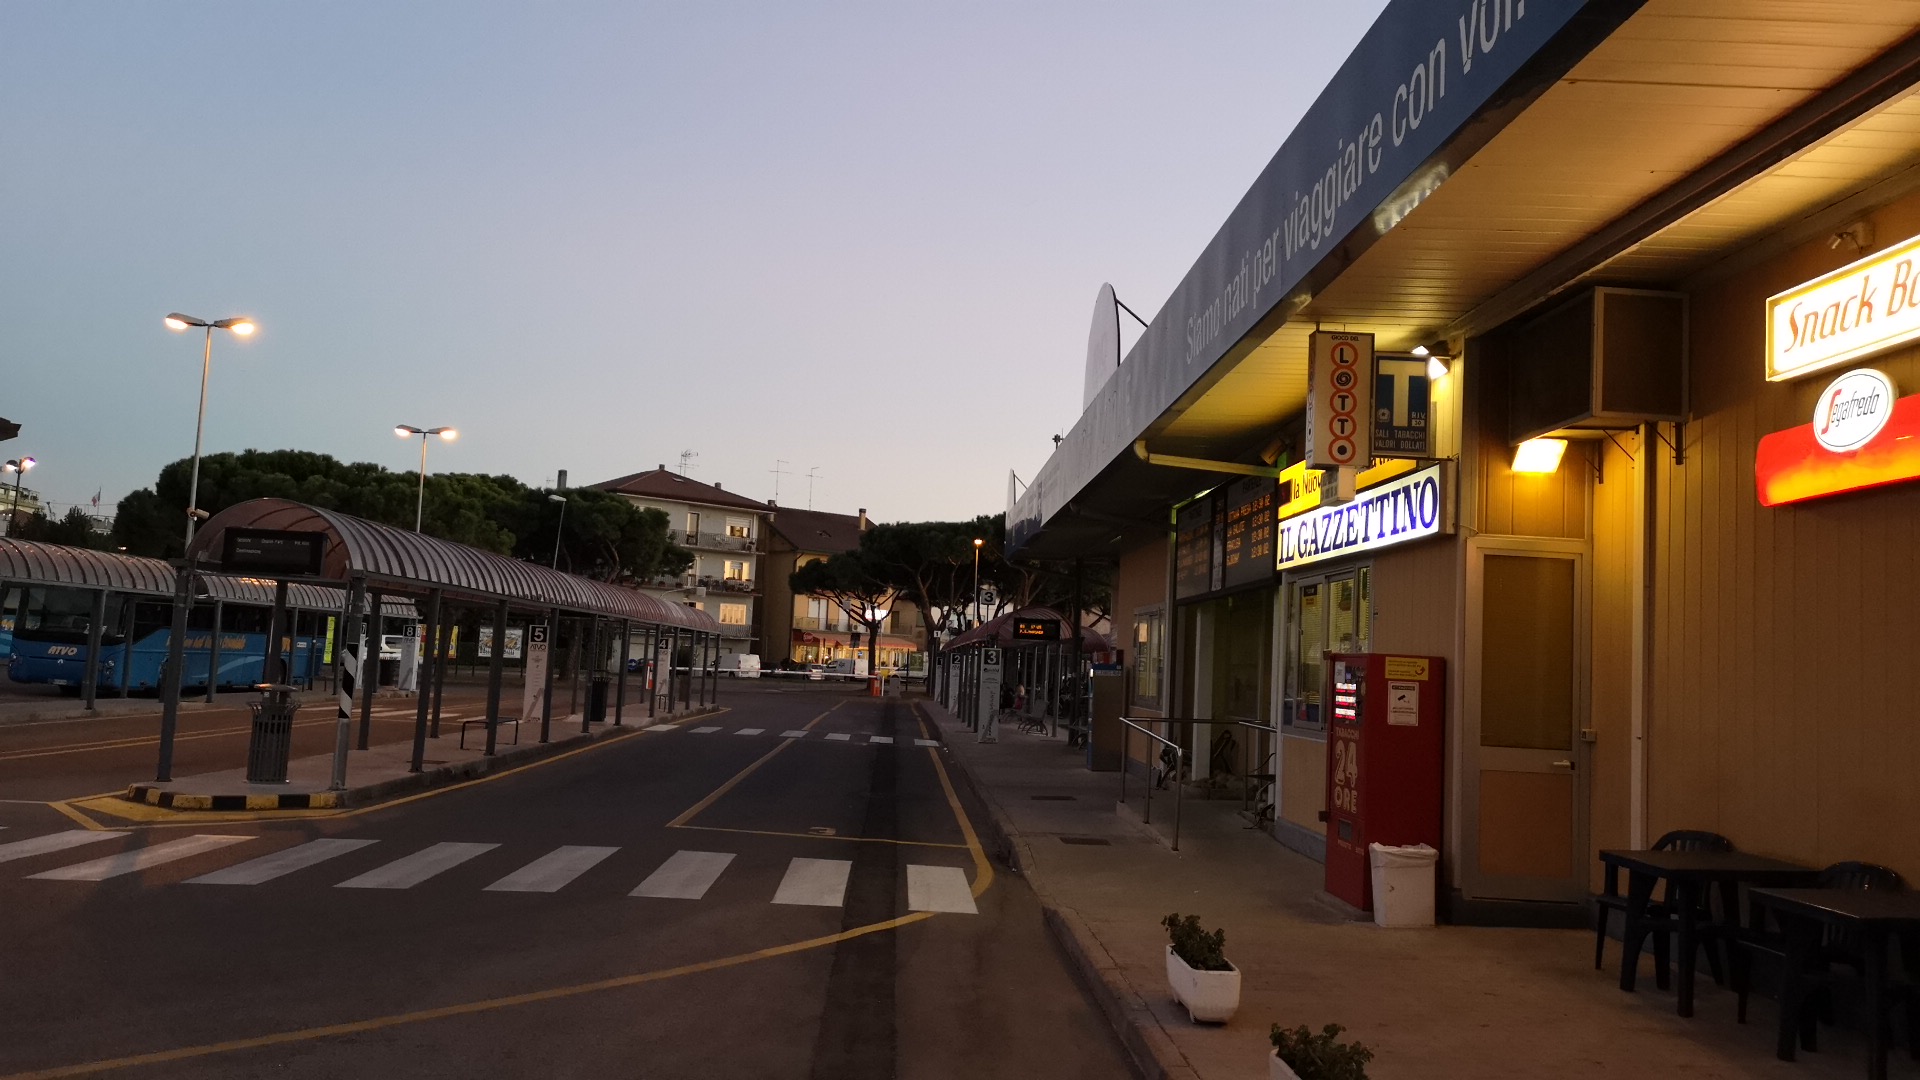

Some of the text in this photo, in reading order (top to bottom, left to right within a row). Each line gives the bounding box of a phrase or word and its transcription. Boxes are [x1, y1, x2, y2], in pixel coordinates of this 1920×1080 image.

[1186, 297, 1220, 364] Siamo
[1224, 250, 1249, 325] nati
[1252, 227, 1280, 310] per
[1284, 112, 1382, 261] viaggiare
[1392, 38, 1446, 147] con
[1784, 274, 1878, 354] Snack
[1821, 386, 1880, 435] Segafredo
[1375, 429, 1389, 438] SALI
[1293, 478, 1300, 500] la
[1278, 525, 1296, 565] IL
[1298, 475, 1439, 559] GAZZETTINO
[984, 591, 994, 603] 3
[406, 626, 414, 637] 8
[533, 627, 544, 642] 5
[47, 645, 78, 656] ATVO
[659, 639, 666, 649] 4
[954, 655, 960, 664] 2
[987, 650, 997, 664] 3
[1334, 739, 1358, 788] 24
[1334, 785, 1358, 814] ORE
